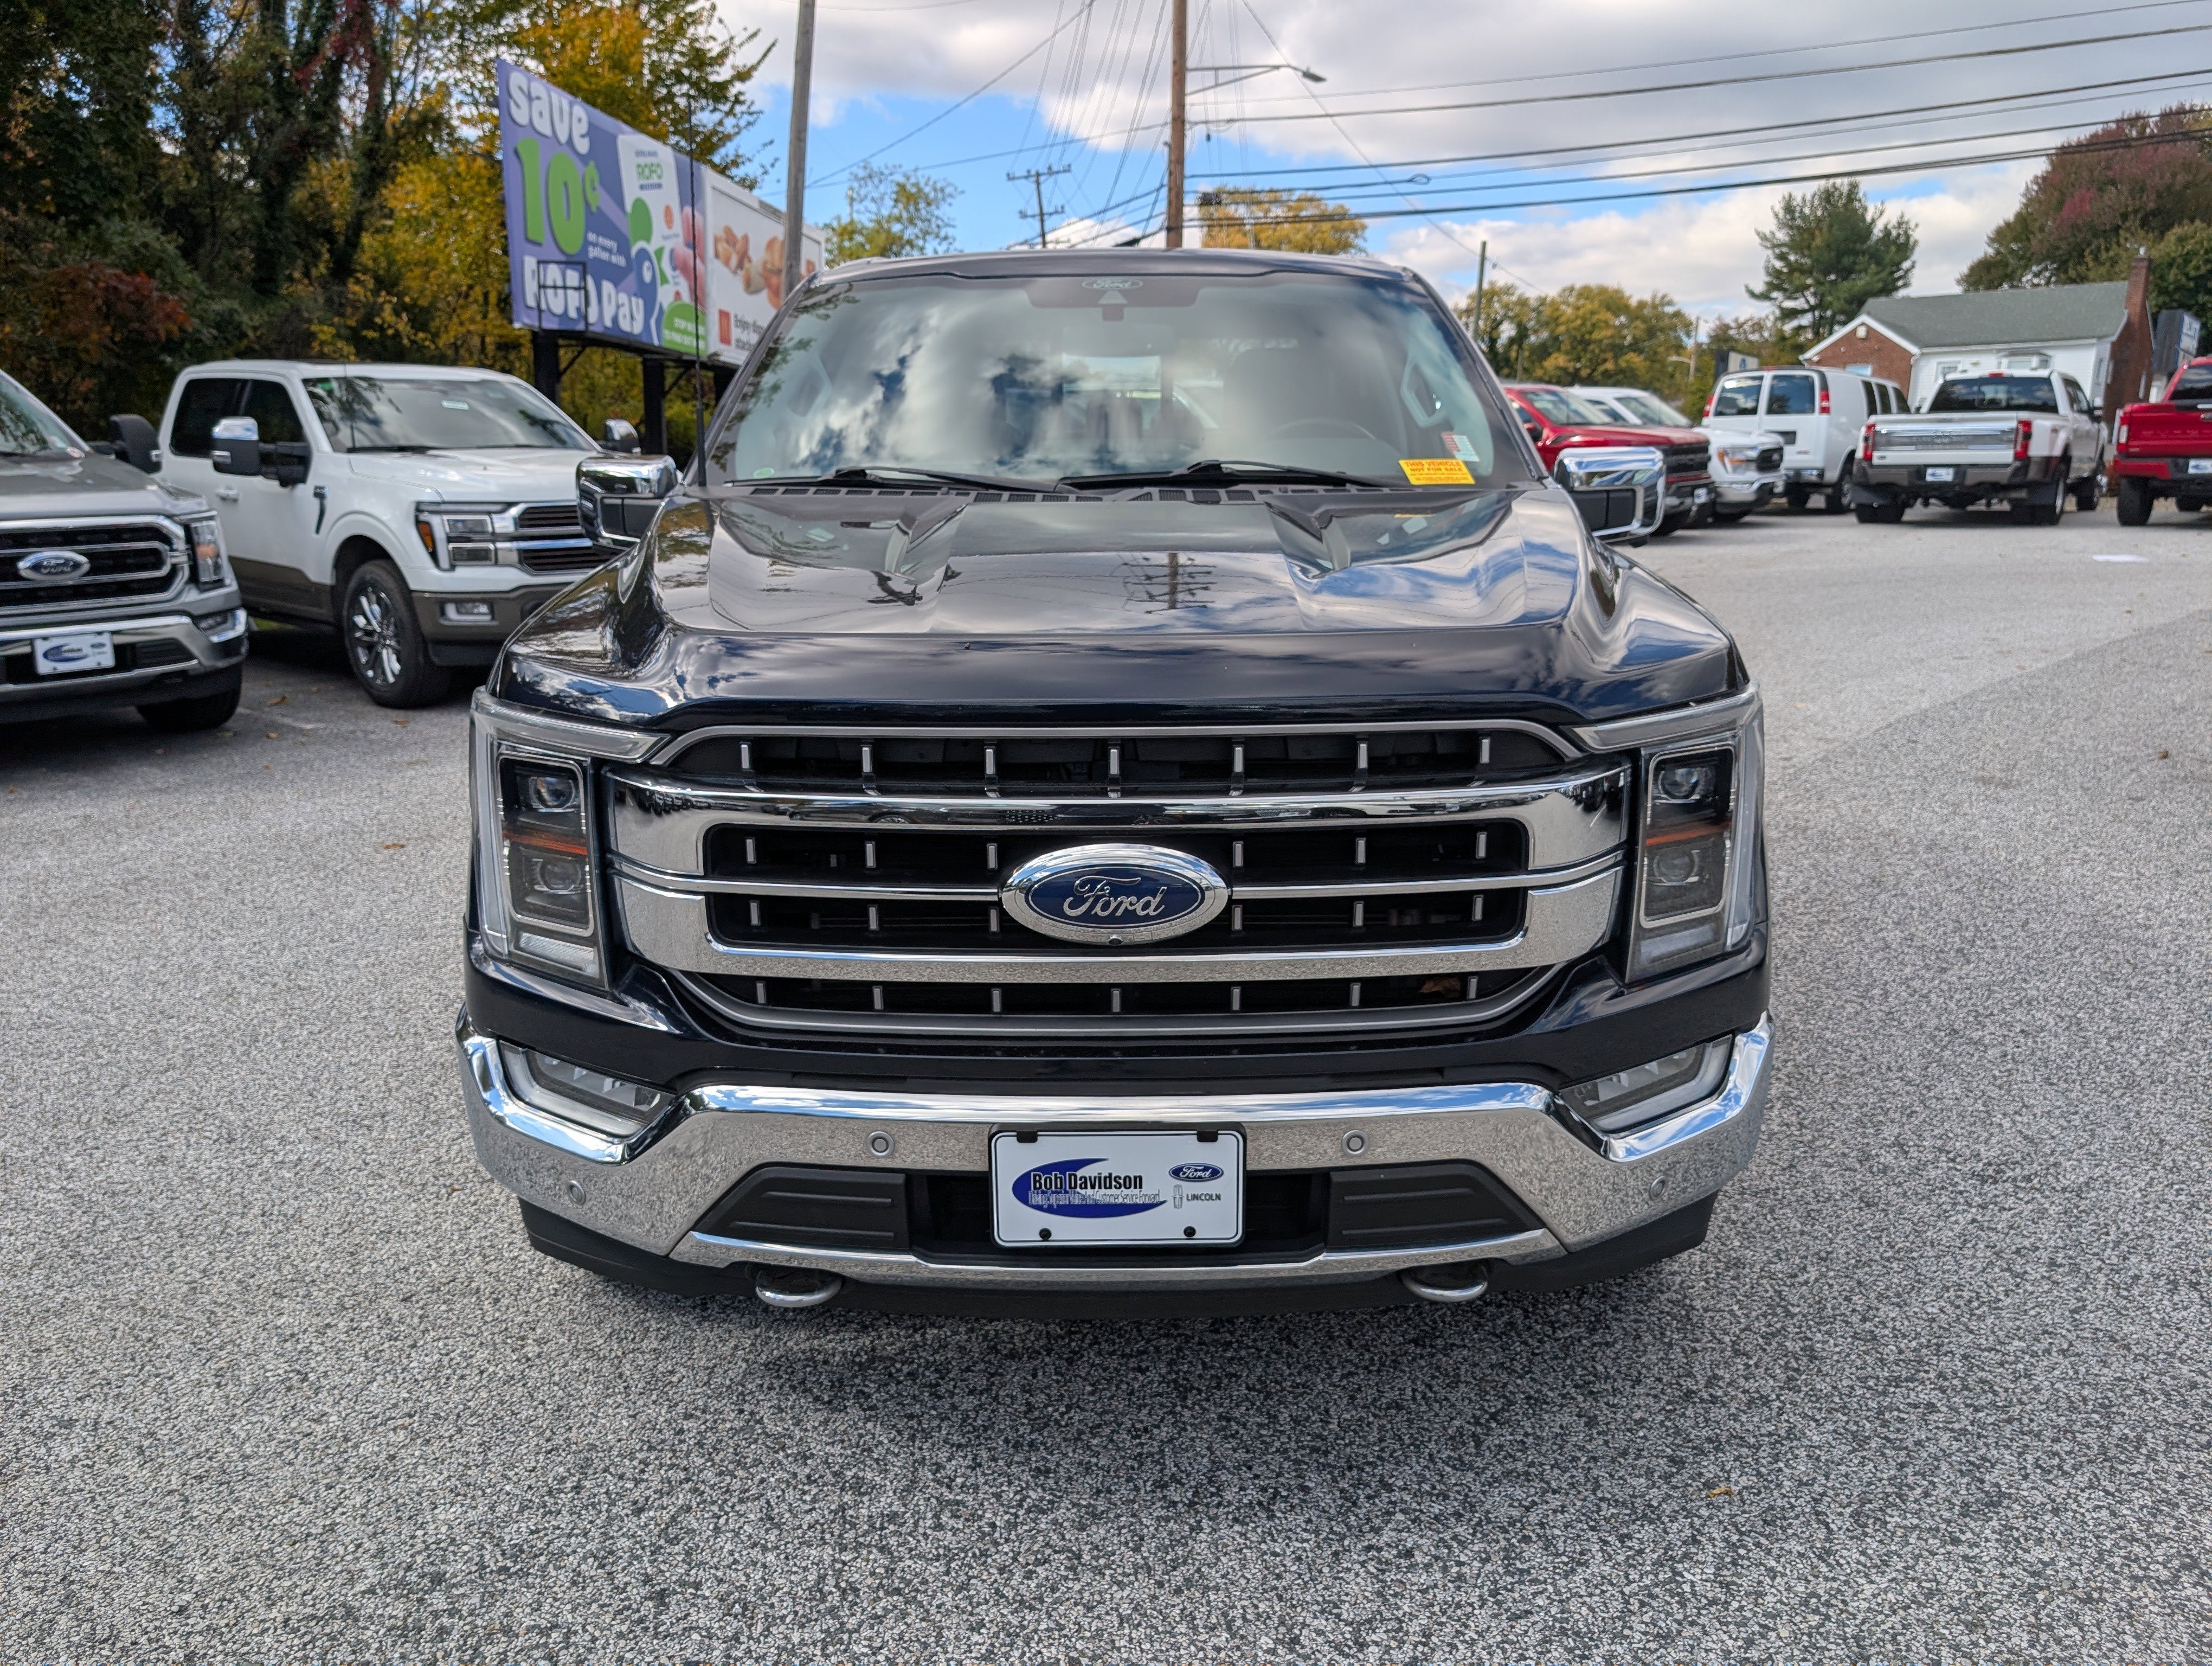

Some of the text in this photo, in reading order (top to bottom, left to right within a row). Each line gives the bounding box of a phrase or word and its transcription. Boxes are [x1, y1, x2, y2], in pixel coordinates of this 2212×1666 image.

[509, 72, 590, 155] save
[1093, 279, 1133, 289] Ford
[601, 279, 645, 335] Pay
[41, 559, 73, 573] Ford
[1063, 875, 1167, 917] Ford
[1180, 1165, 1213, 1178] Ford
[1032, 1172, 1143, 1190] Bob Davidson
[1186, 1193, 1221, 1202] LINCOLN
